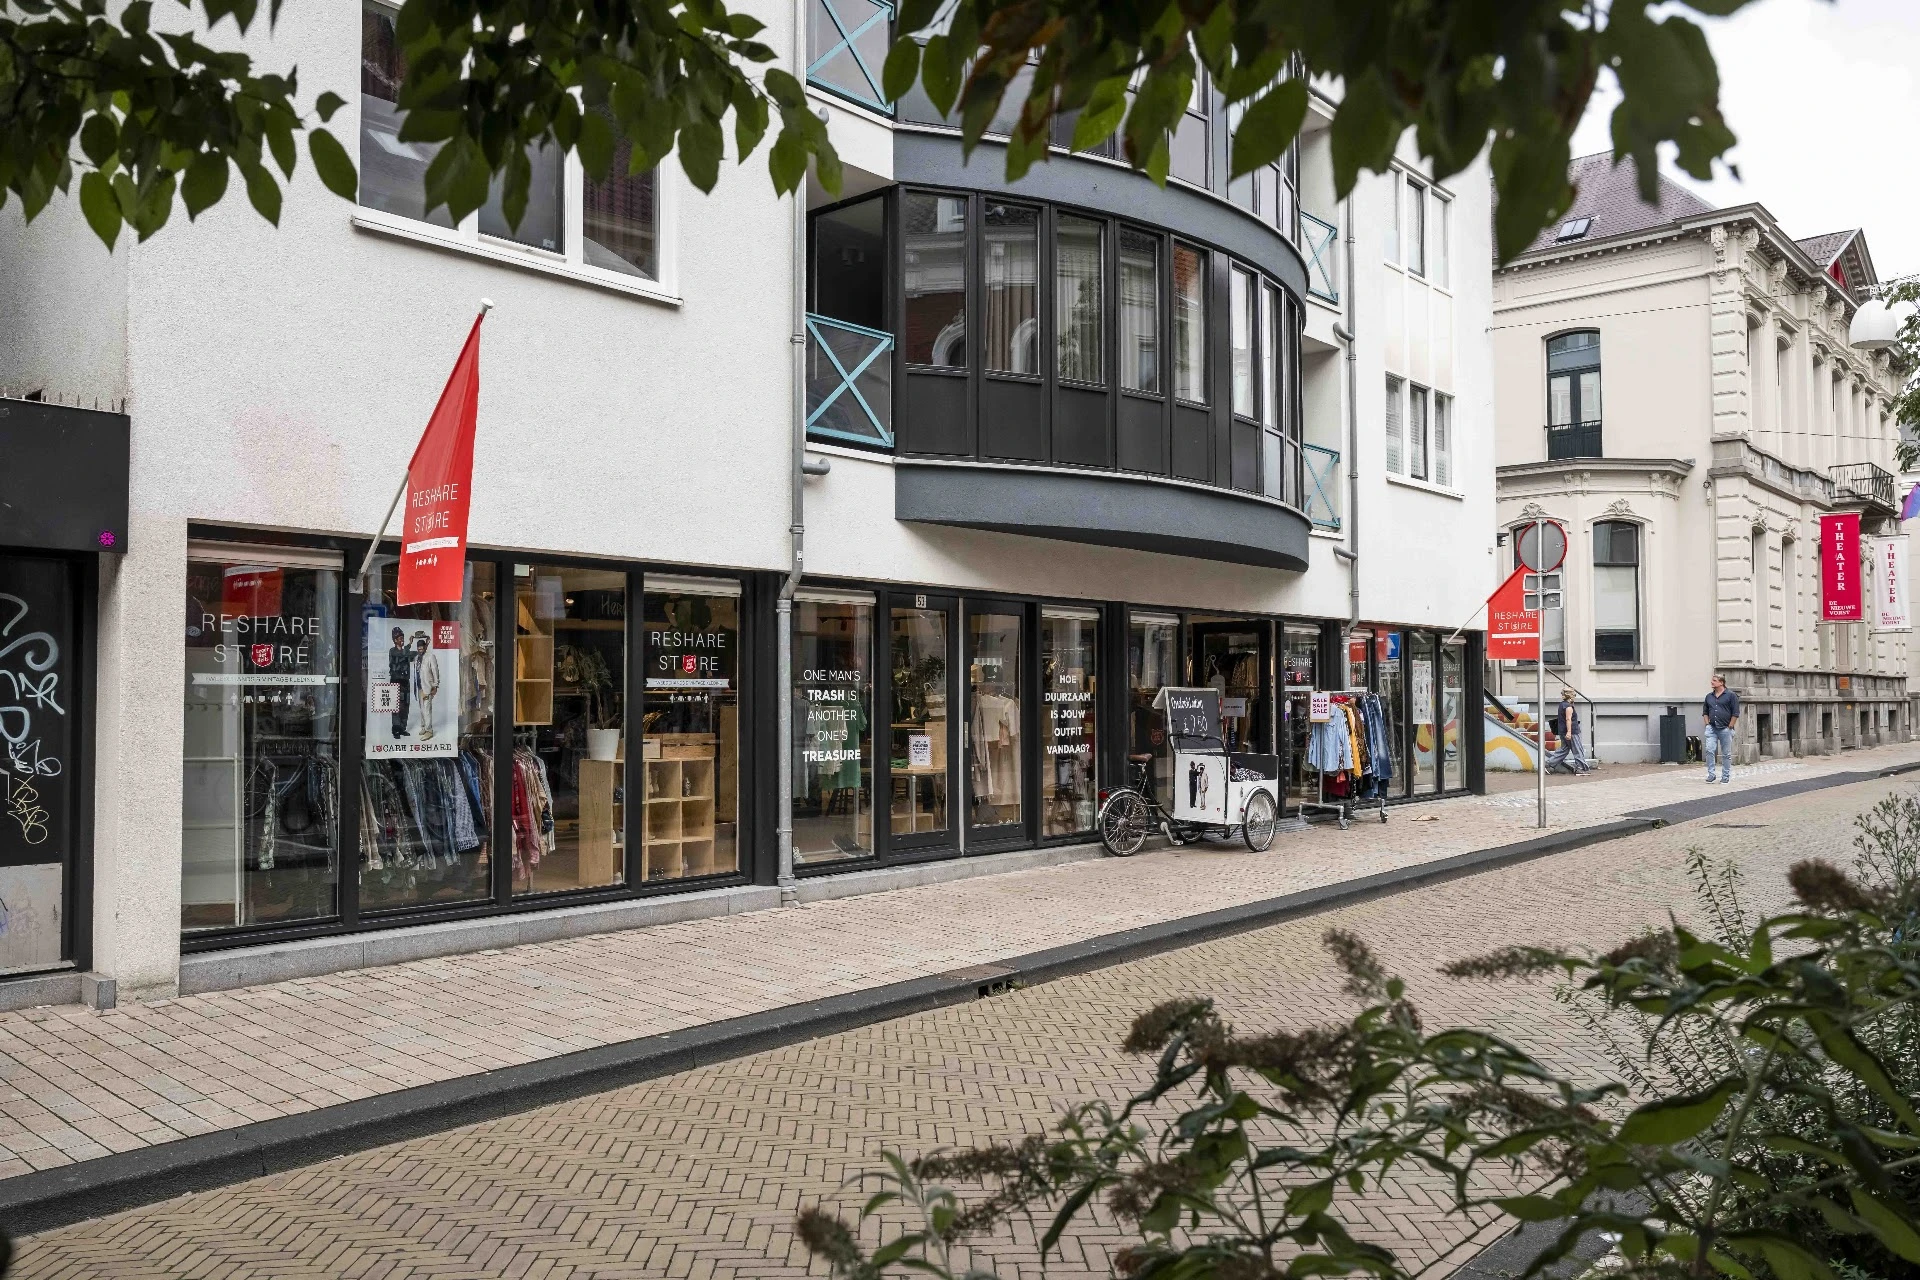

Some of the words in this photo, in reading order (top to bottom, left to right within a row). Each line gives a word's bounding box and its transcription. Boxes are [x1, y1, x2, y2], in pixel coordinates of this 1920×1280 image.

[412, 483, 459, 508] RESHARE
[1834, 522, 1846, 591] THEATER
[1887, 543, 1897, 604] THEATER
[1494, 611, 1538, 620] RESHARE
[201, 613, 320, 636] RESHARE
[651, 631, 726, 648] RESHARE
[803, 669, 827, 681] ONE
[829, 669, 861, 681] MAN'S
[1059, 675, 1077, 684] HOE
[807, 689, 845, 701] TRASH
[847, 690, 857, 701] IS
[1045, 692, 1091, 702] DUURZAAM
[807, 709, 857, 721] ANOTHER
[1050, 709, 1058, 719] IS
[1060, 709, 1086, 719] JOUW
[817, 729, 849, 741] ONE'S
[1054, 726, 1083, 737] OUTFIT
[420, 743, 452, 752] SHARE
[1046, 743, 1090, 755] VANDAAG?
[802, 748, 862, 763] TREASURE
